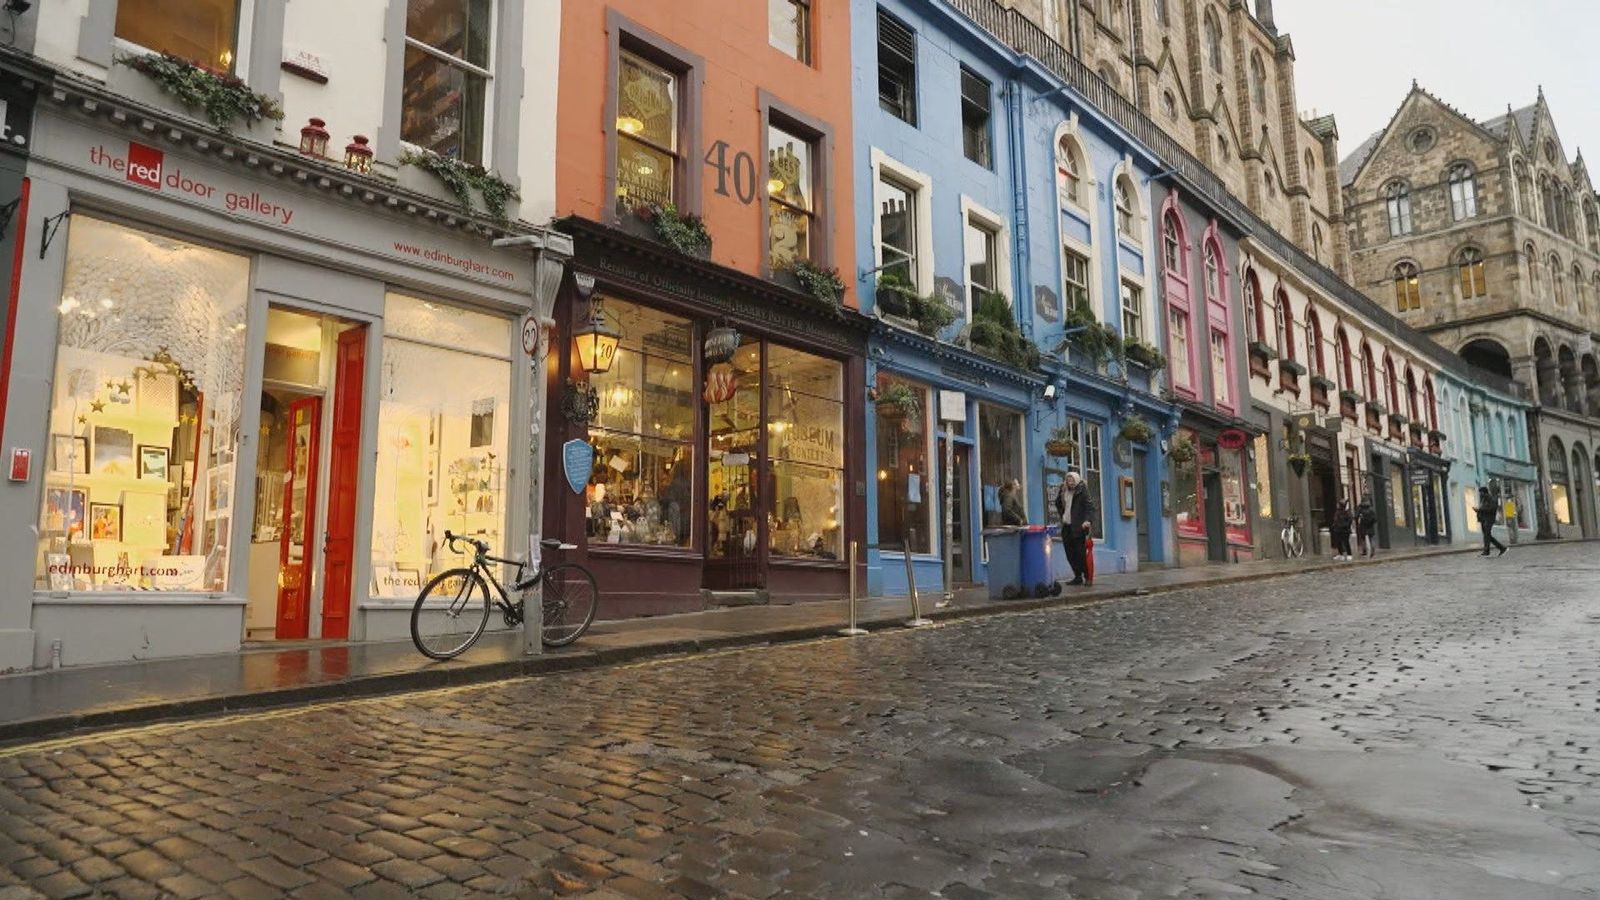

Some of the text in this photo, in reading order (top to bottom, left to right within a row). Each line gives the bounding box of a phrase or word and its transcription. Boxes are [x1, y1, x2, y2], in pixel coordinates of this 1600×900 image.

[90, 145, 294, 225] the red door gallery
[704, 140, 756, 205] 40
[393, 241, 514, 281] www.edinburghart.com
[48, 561, 178, 578] edinburghart.com
[383, 576, 400, 586] the
[403, 576, 420, 586] red
